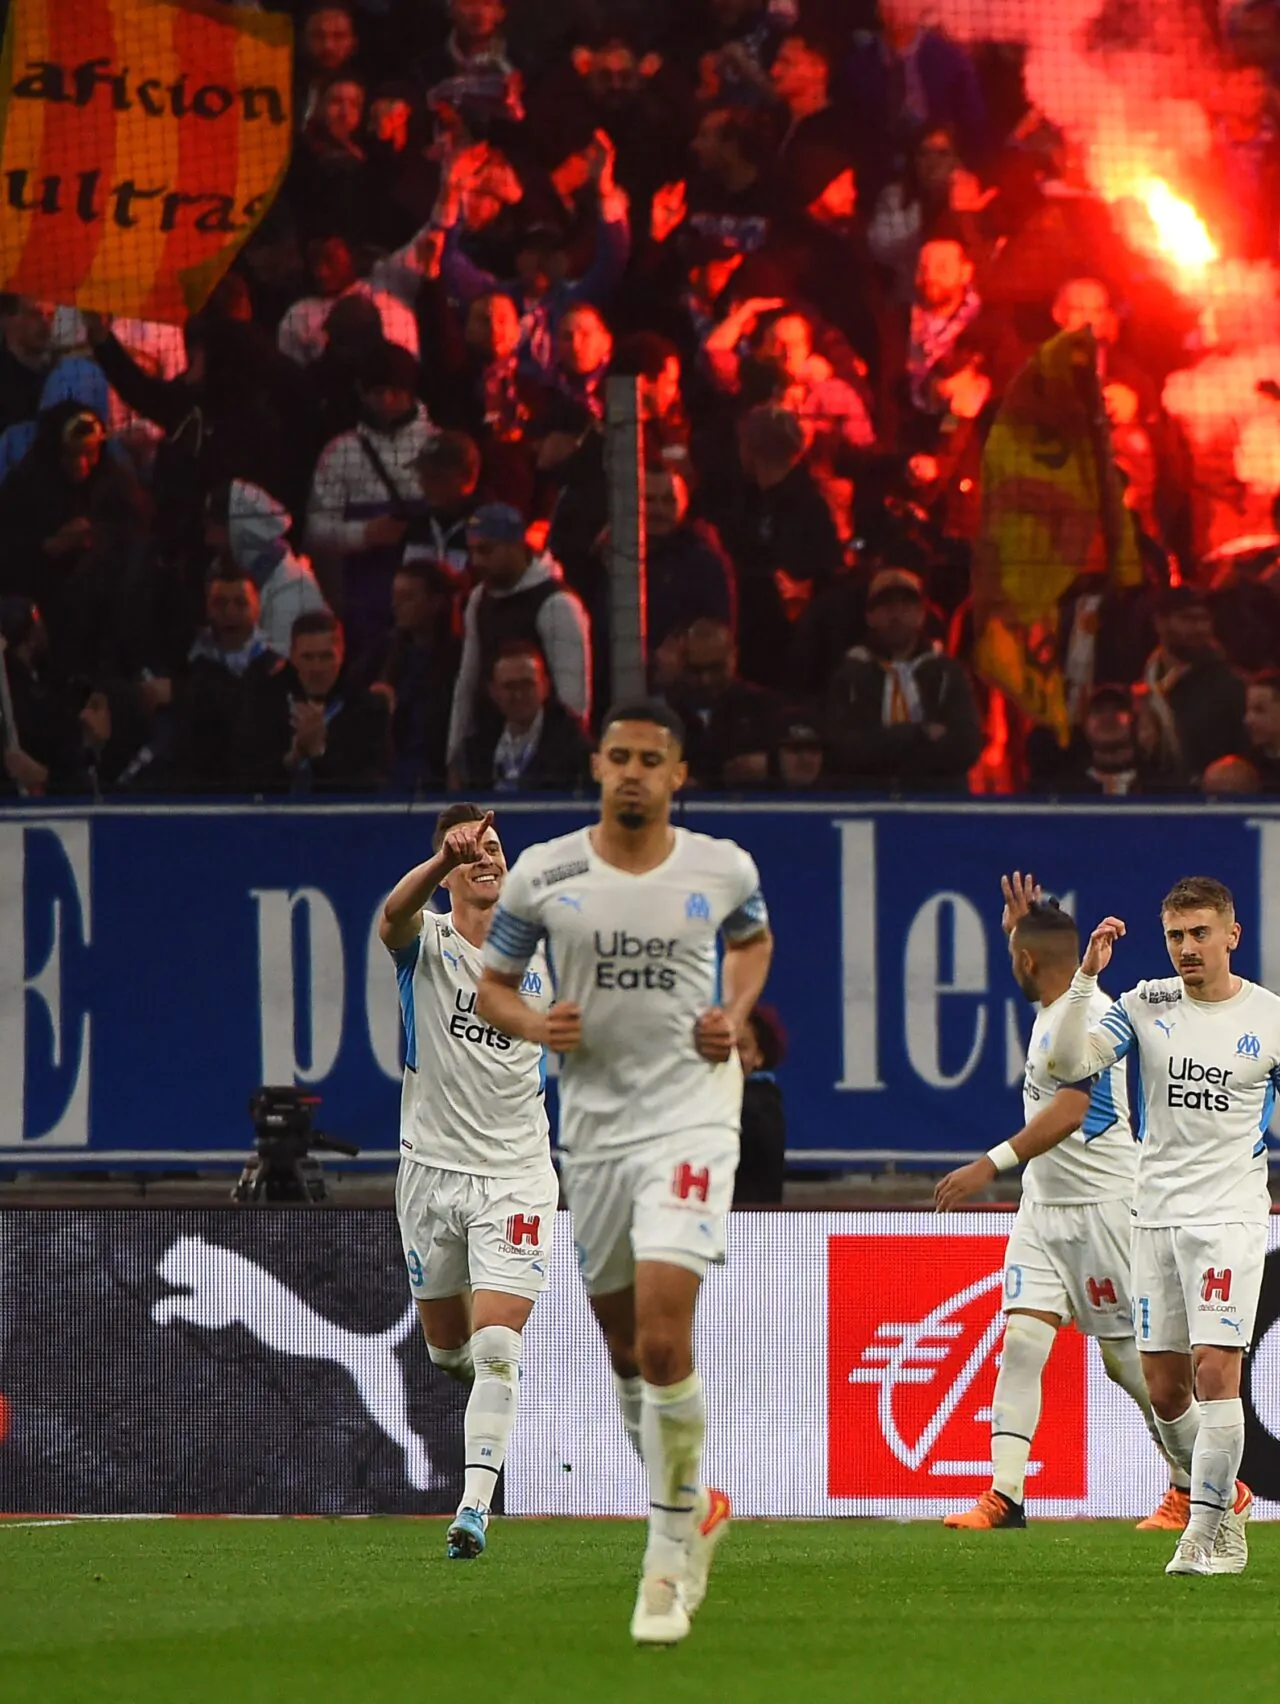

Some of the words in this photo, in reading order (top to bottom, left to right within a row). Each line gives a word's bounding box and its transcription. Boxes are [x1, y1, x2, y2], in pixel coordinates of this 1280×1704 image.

[13, 57, 287, 125] aficion
[594, 930, 679, 958] Uber
[596, 962, 677, 990] Eats
[449, 1014, 512, 1051] Eats
[1168, 1056, 1233, 1087] Uber
[1167, 1084, 1230, 1112] Eats
[407, 1249, 424, 1287] 9
